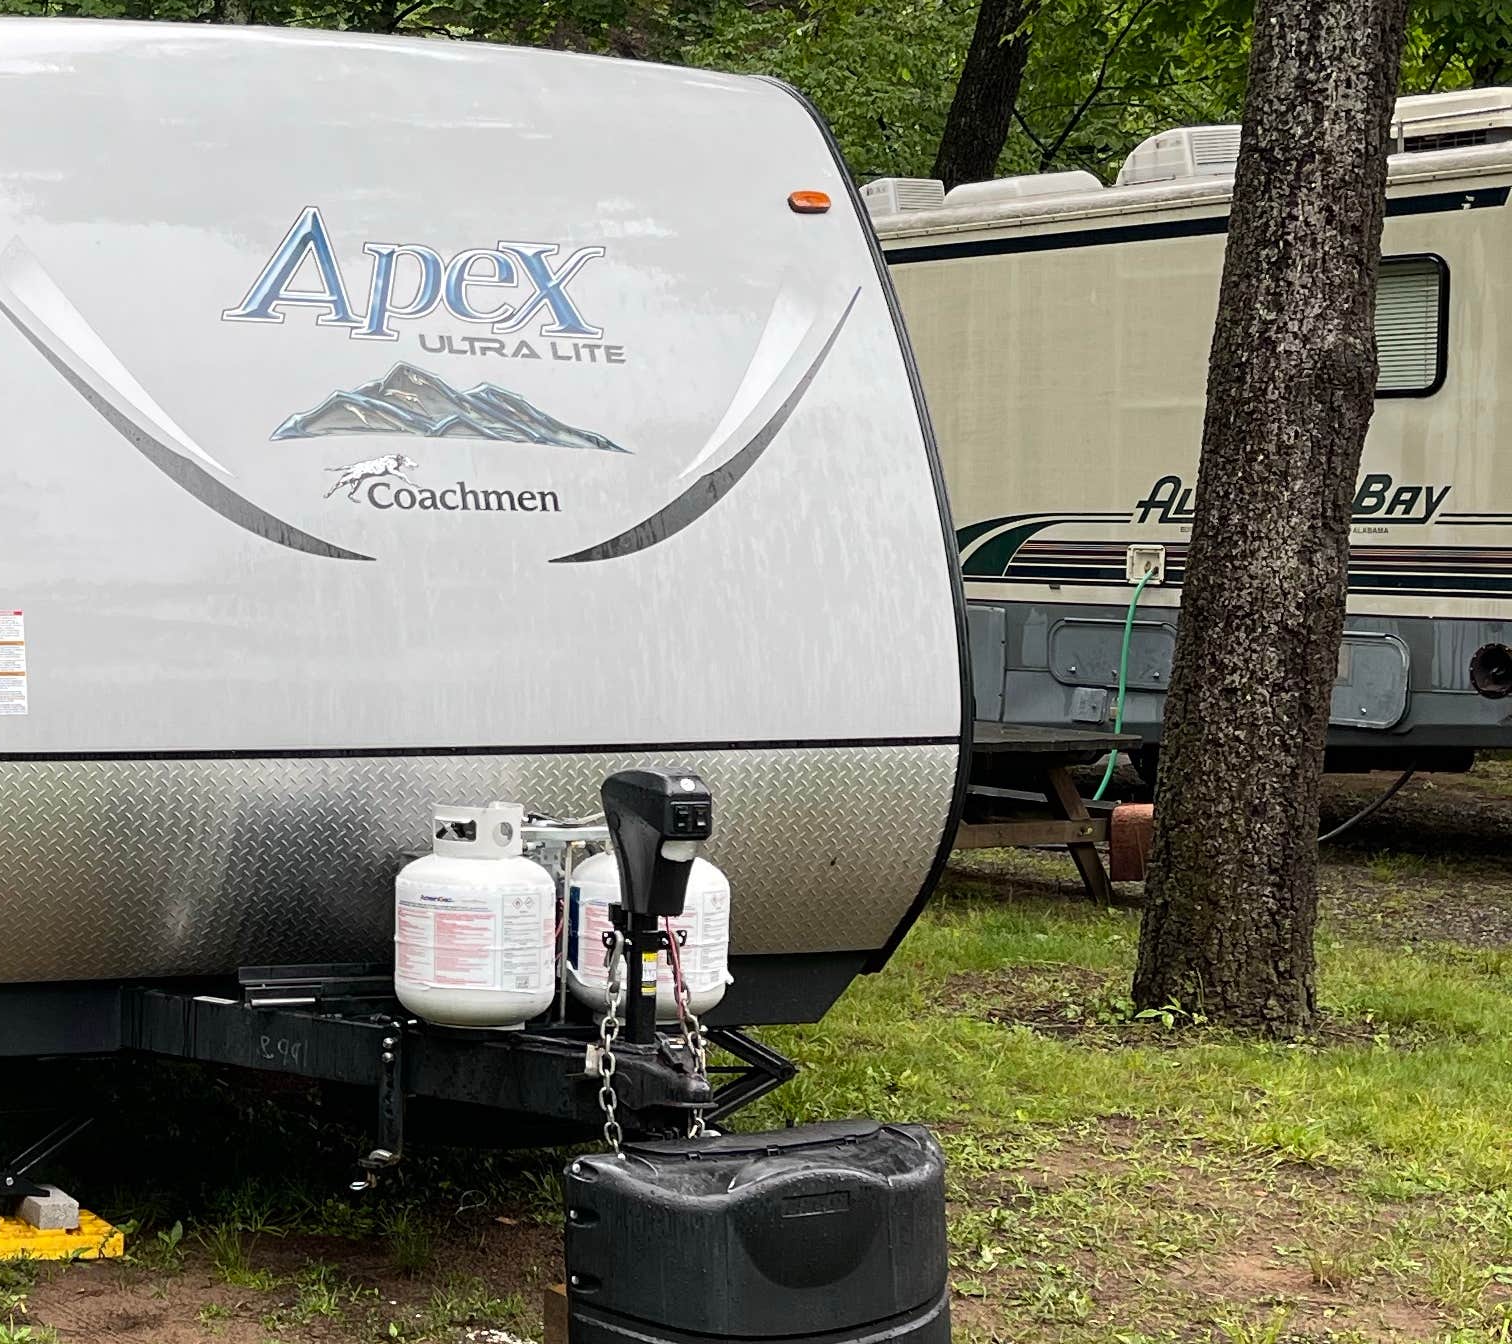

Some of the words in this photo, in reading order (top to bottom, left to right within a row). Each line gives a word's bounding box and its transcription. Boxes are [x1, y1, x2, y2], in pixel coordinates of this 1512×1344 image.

[221, 205, 606, 342] Apex
[419, 334, 542, 360] ULTRA
[550, 341, 627, 364] LITE
[367, 481, 562, 512] Coachmen
